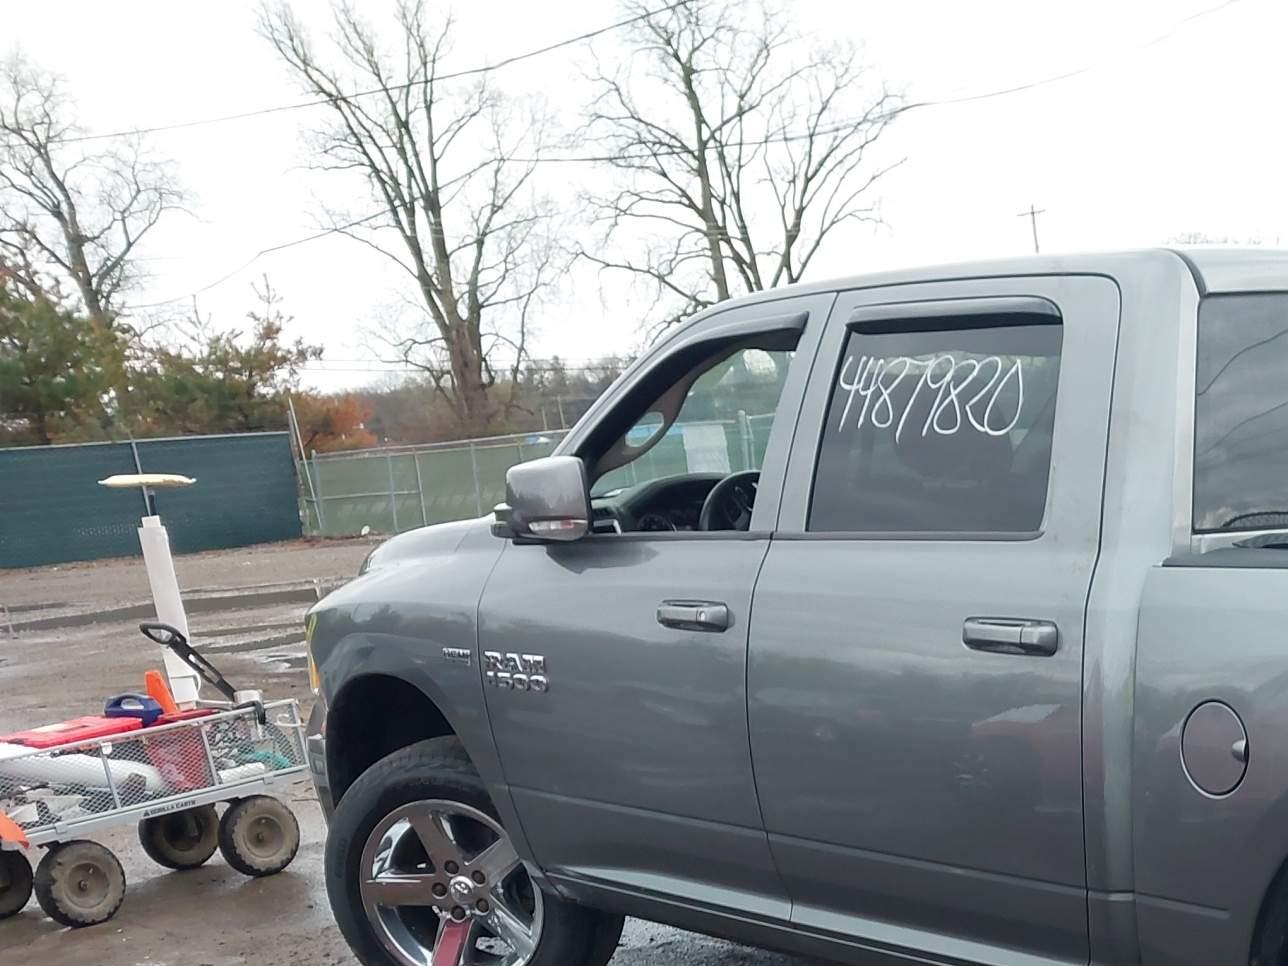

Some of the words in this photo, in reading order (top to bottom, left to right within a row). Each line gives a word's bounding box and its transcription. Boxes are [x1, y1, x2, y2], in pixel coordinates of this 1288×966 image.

[838, 355, 1024, 444] 44879820
[484, 650, 545, 673] RAM
[486, 670, 549, 692] 1500
